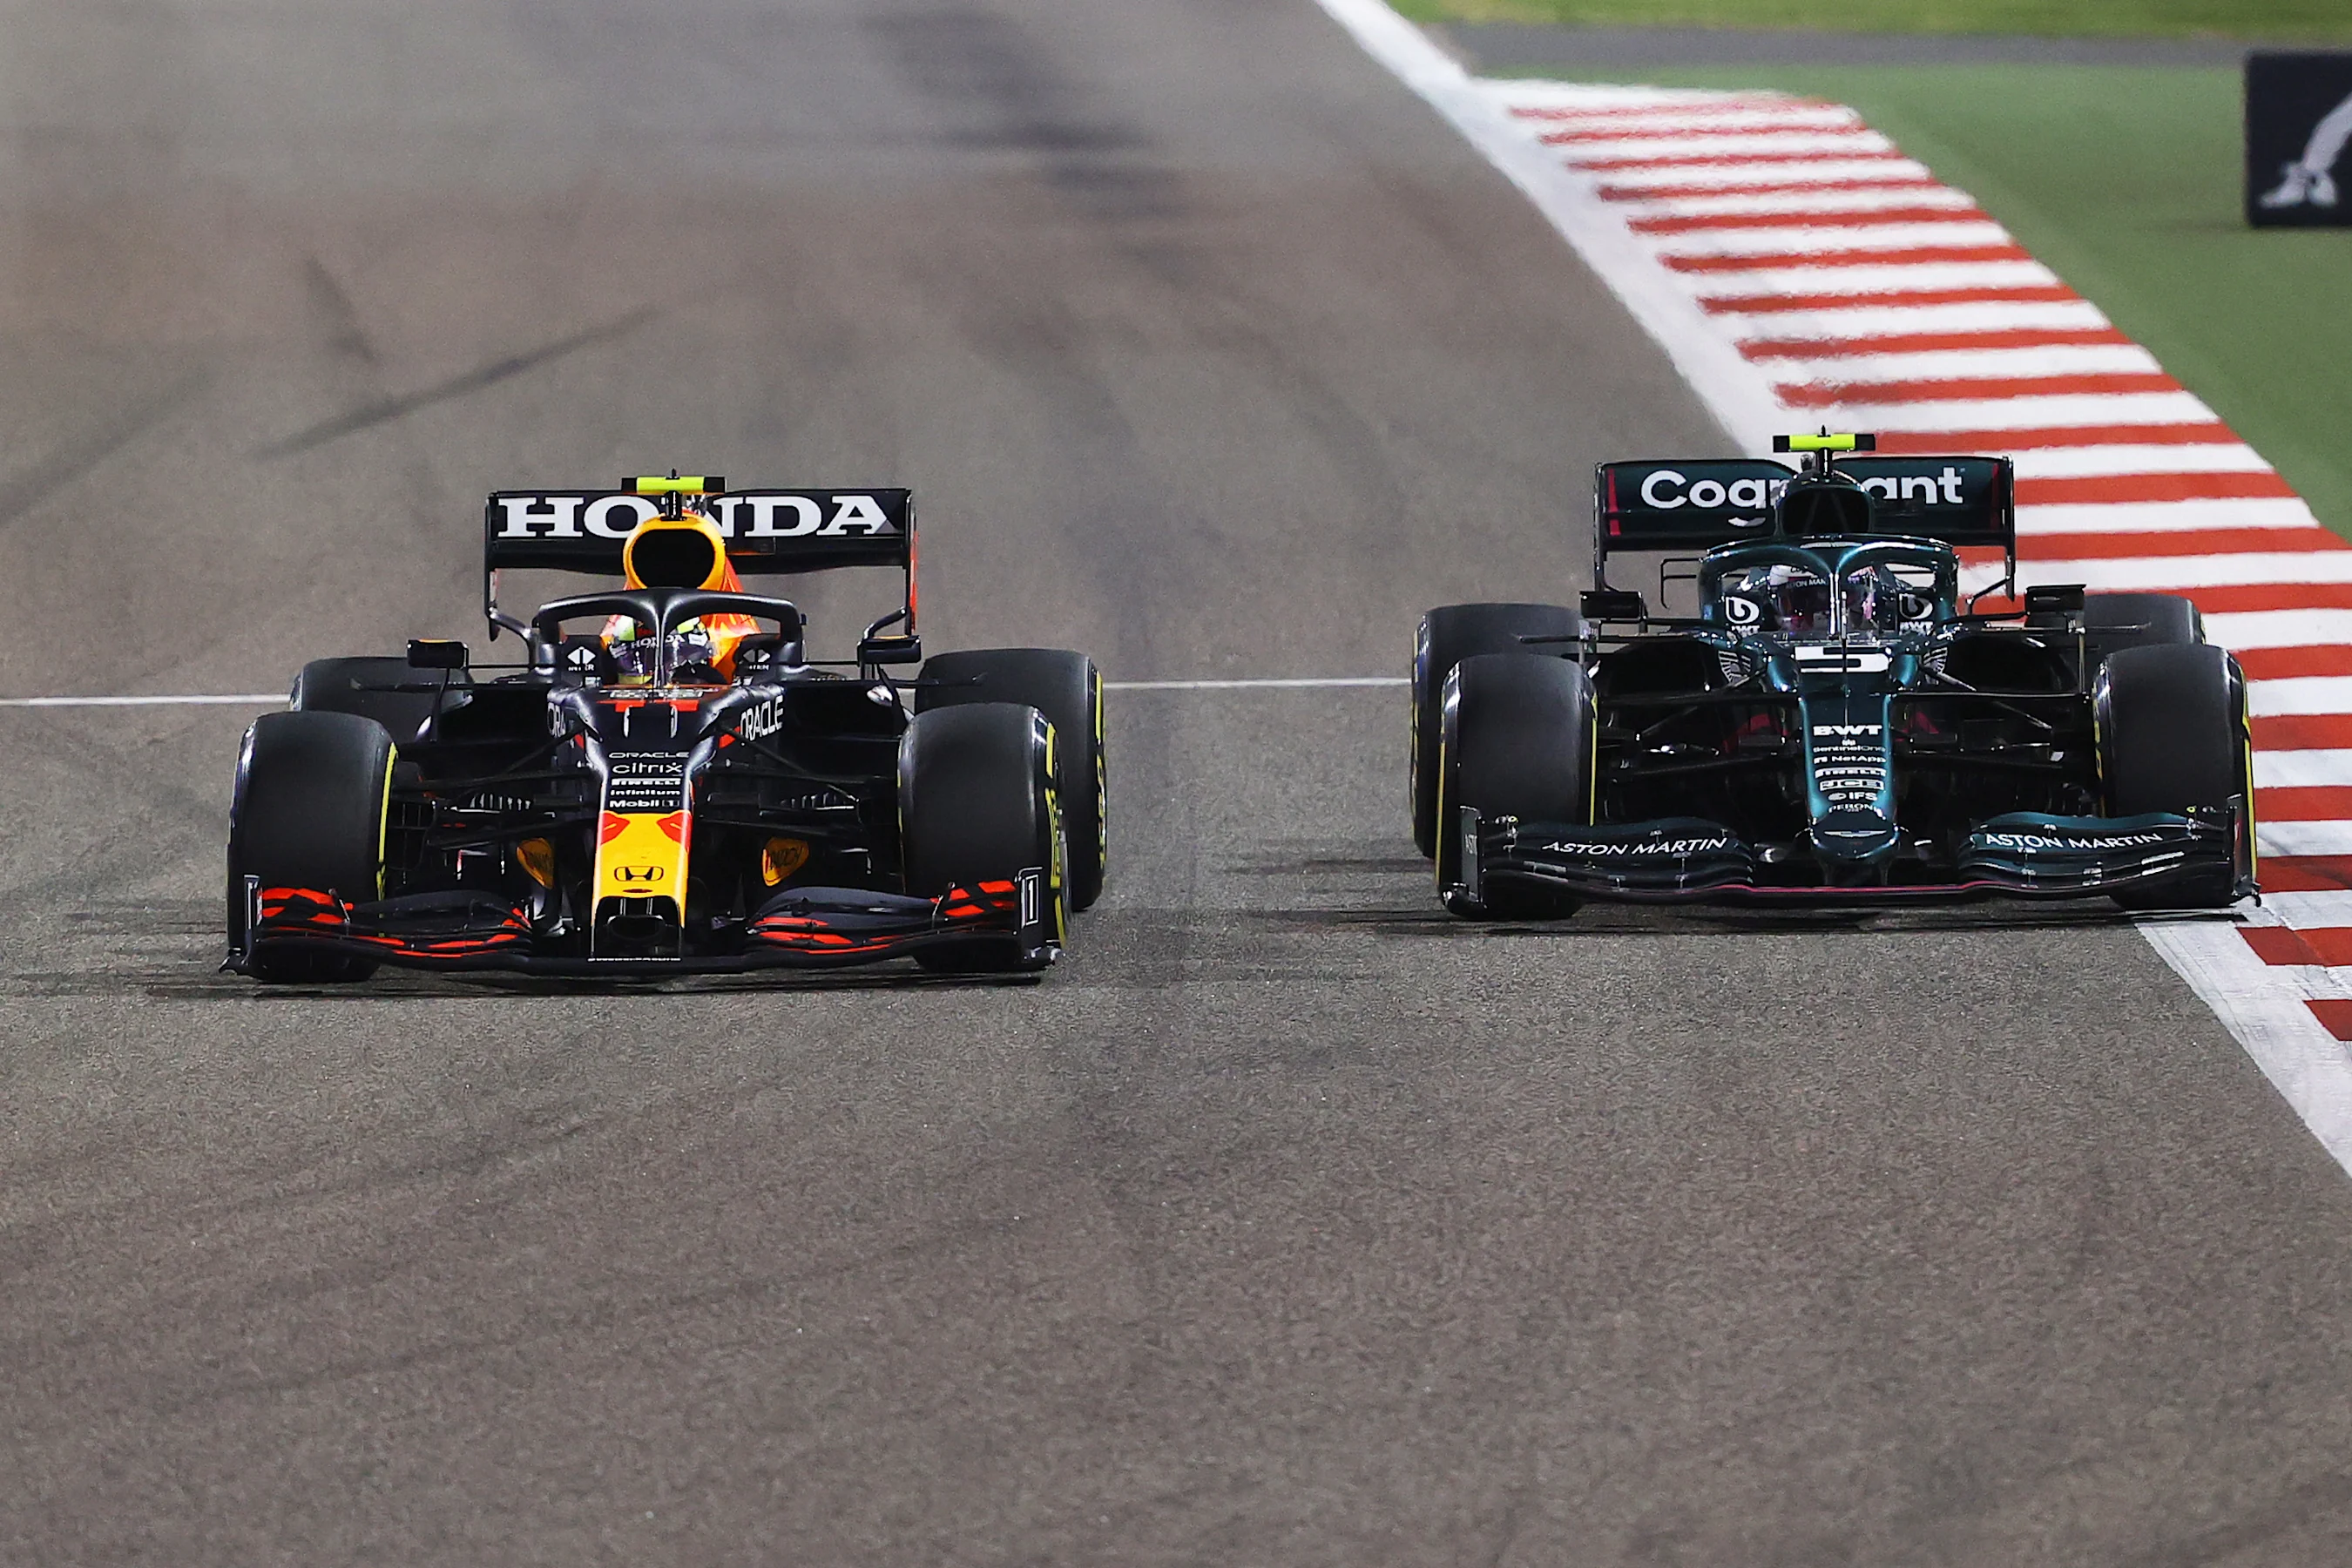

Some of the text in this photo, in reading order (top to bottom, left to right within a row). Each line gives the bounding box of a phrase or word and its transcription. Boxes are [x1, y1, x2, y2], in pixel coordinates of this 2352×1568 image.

[1640, 467, 1963, 528] Cogant
[1794, 645, 1889, 672] 5
[740, 694, 784, 741] ORACLE
[1813, 725, 1882, 736] BWT
[609, 799, 659, 808] Mobil
[1848, 791, 1877, 801] IFS
[1542, 837, 1727, 855] ASTON MARTIN
[1985, 833, 2163, 848] ASTON MARTIN
